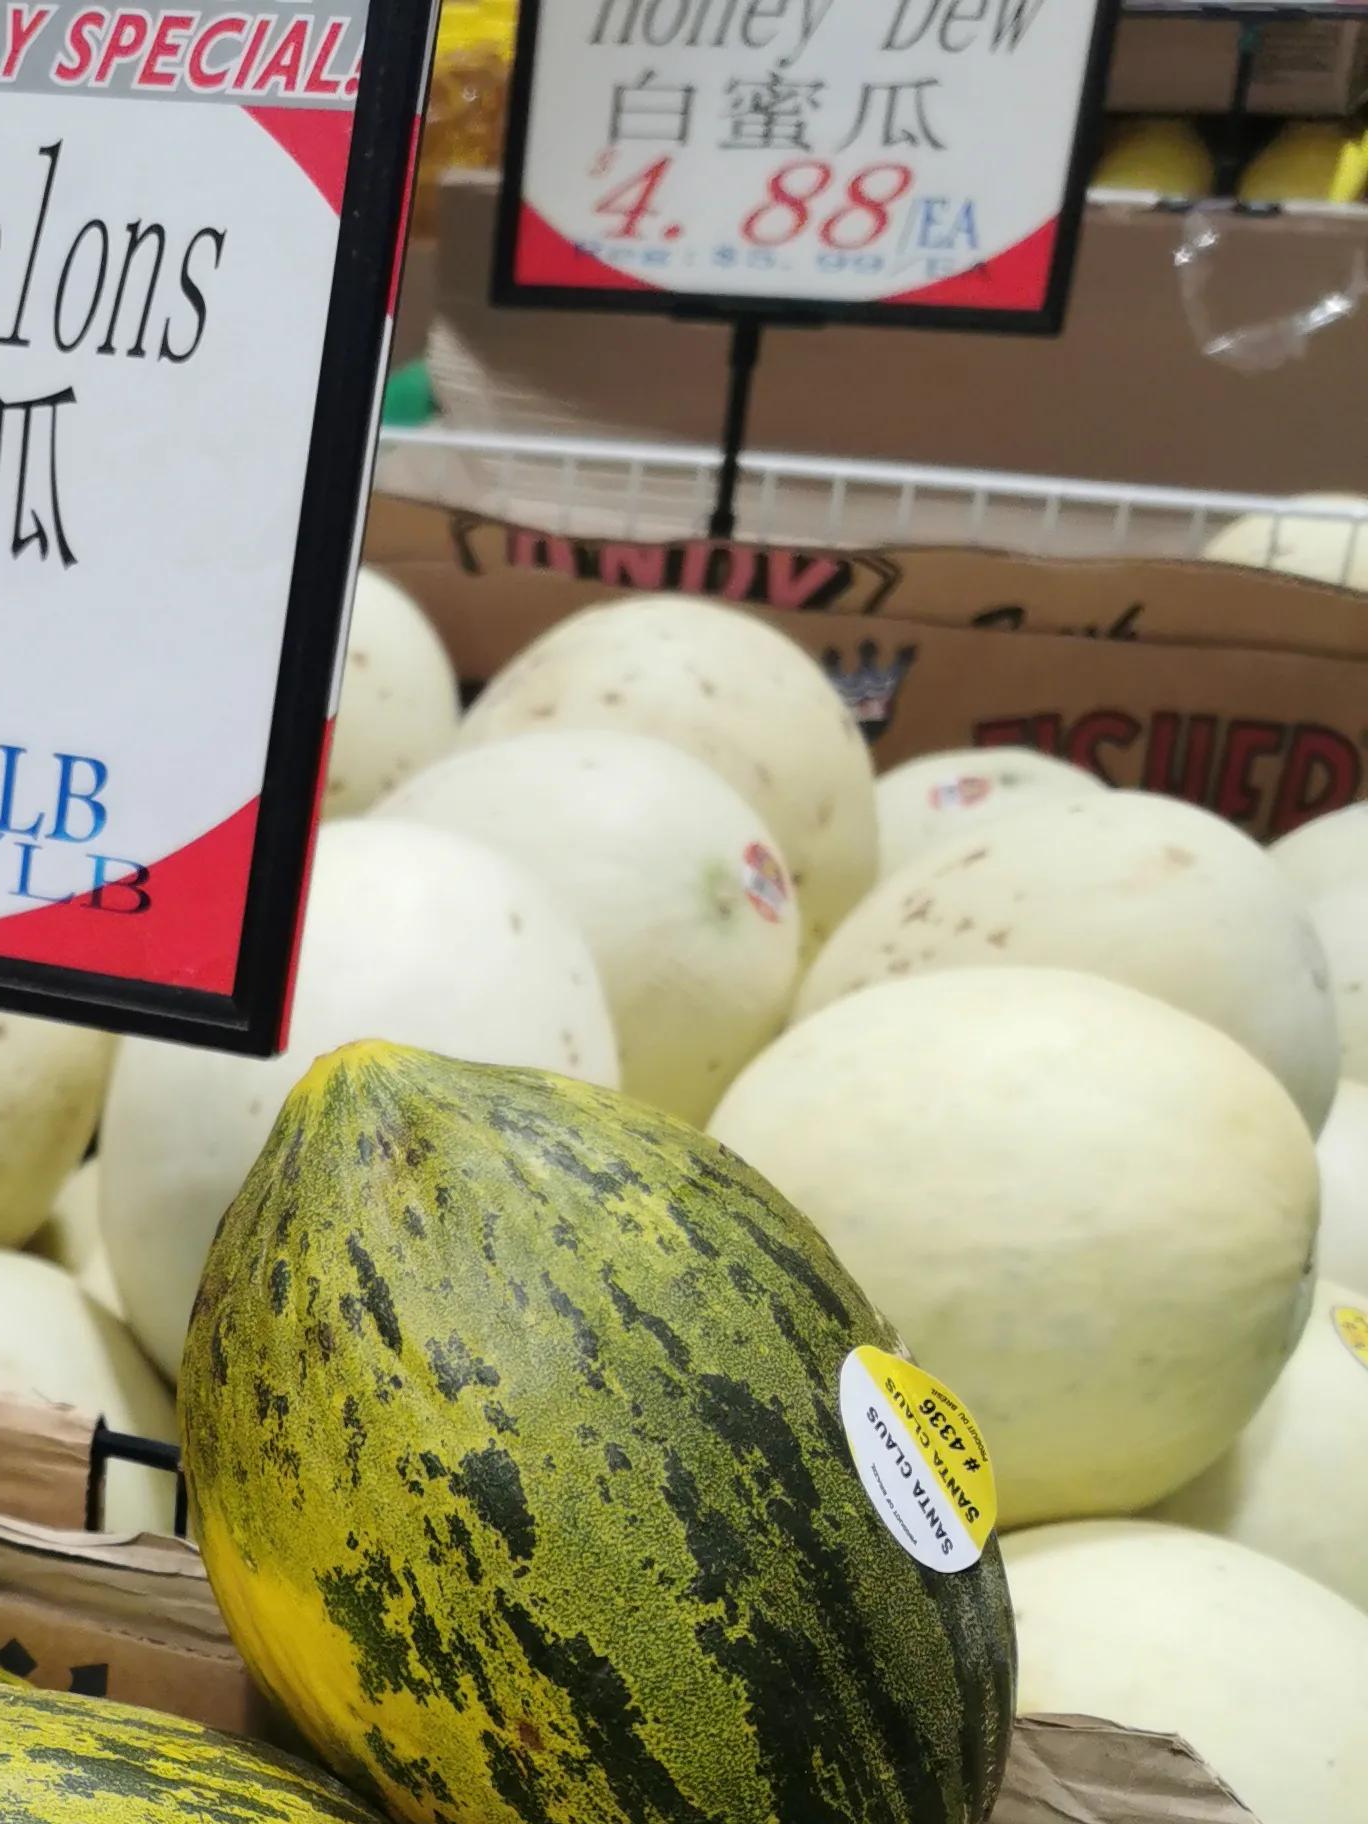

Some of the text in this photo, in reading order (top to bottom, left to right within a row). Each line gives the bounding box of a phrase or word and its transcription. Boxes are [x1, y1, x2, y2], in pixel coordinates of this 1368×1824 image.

[606, 69, 949, 153] 白蜜瓜
[866, 1406, 954, 1555] SANTA CLAUS
[885, 1377, 980, 1523] SANTA CLAUS
[920, 1398, 966, 1452] 4336
